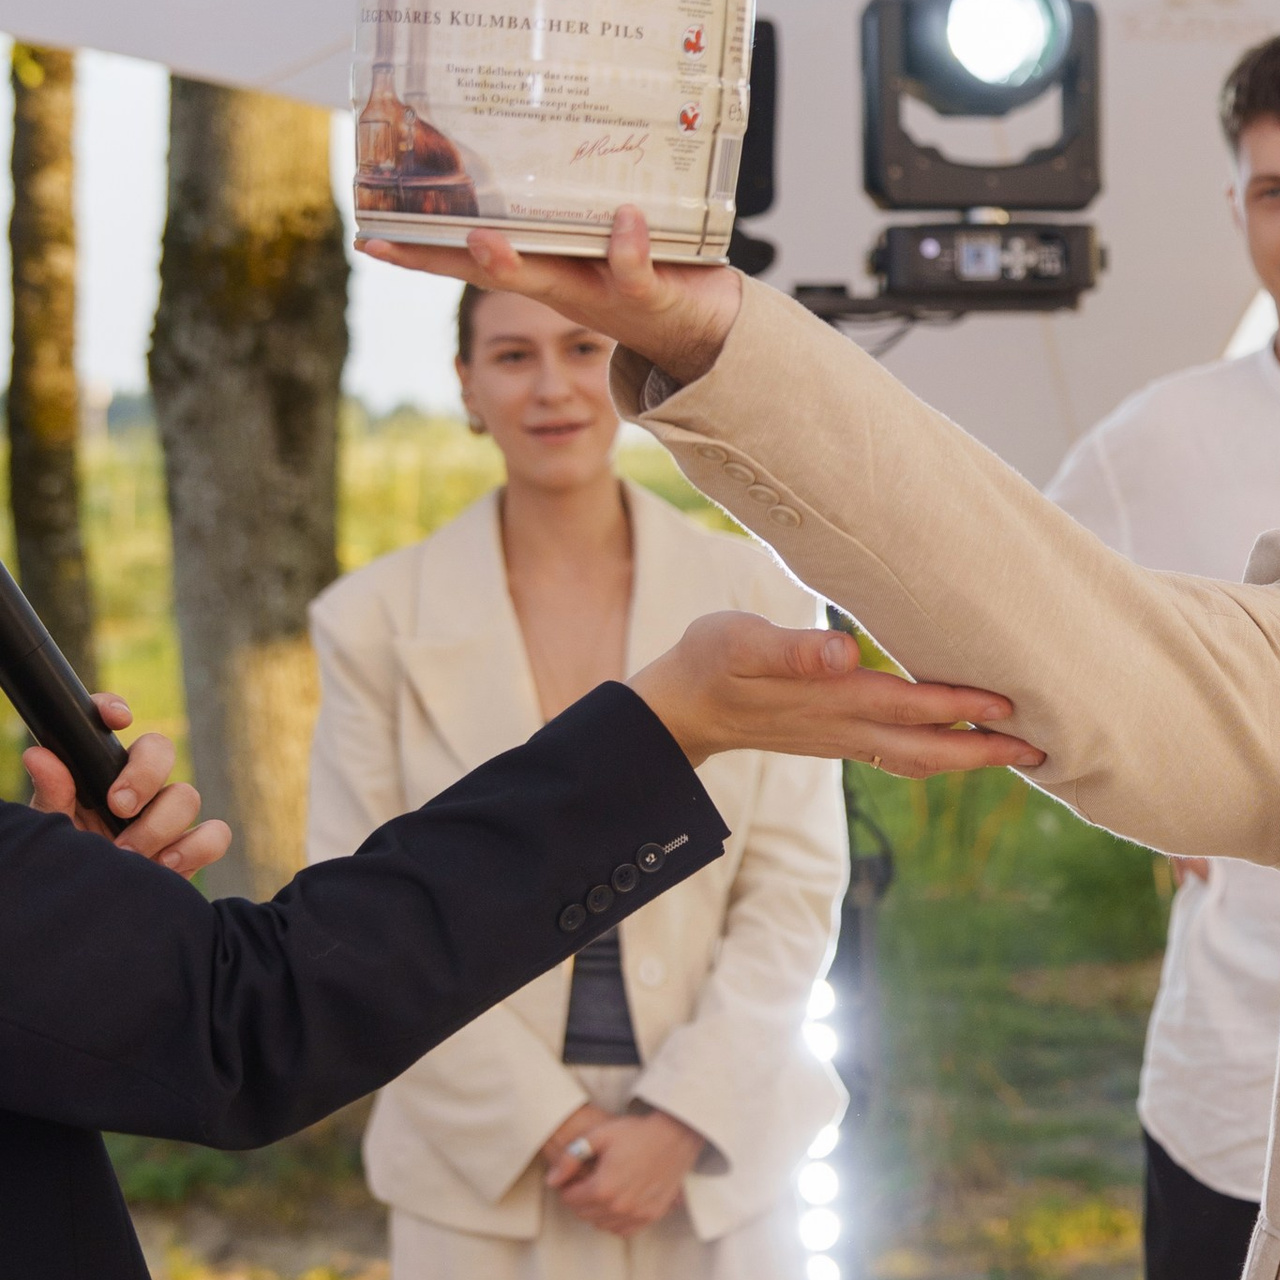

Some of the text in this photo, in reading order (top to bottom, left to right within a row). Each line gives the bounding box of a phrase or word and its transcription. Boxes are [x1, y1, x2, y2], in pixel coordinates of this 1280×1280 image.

[361, 7, 442, 25] LEGENDÄRES
[600, 22, 645, 40] PILS
[446, 63, 474, 74] Unser
[478, 65, 525, 77] Edelherb
[543, 70, 560, 80] das
[457, 77, 589, 97] Kulmbacher Pi und wird
[465, 93, 488, 103] nach
[491, 94, 567, 110] Originaezept
[473, 106, 650, 128] In Erinnerung an die Brauerfamilie
[510, 203, 527, 214] Mit
[529, 205, 584, 219] integriertem
